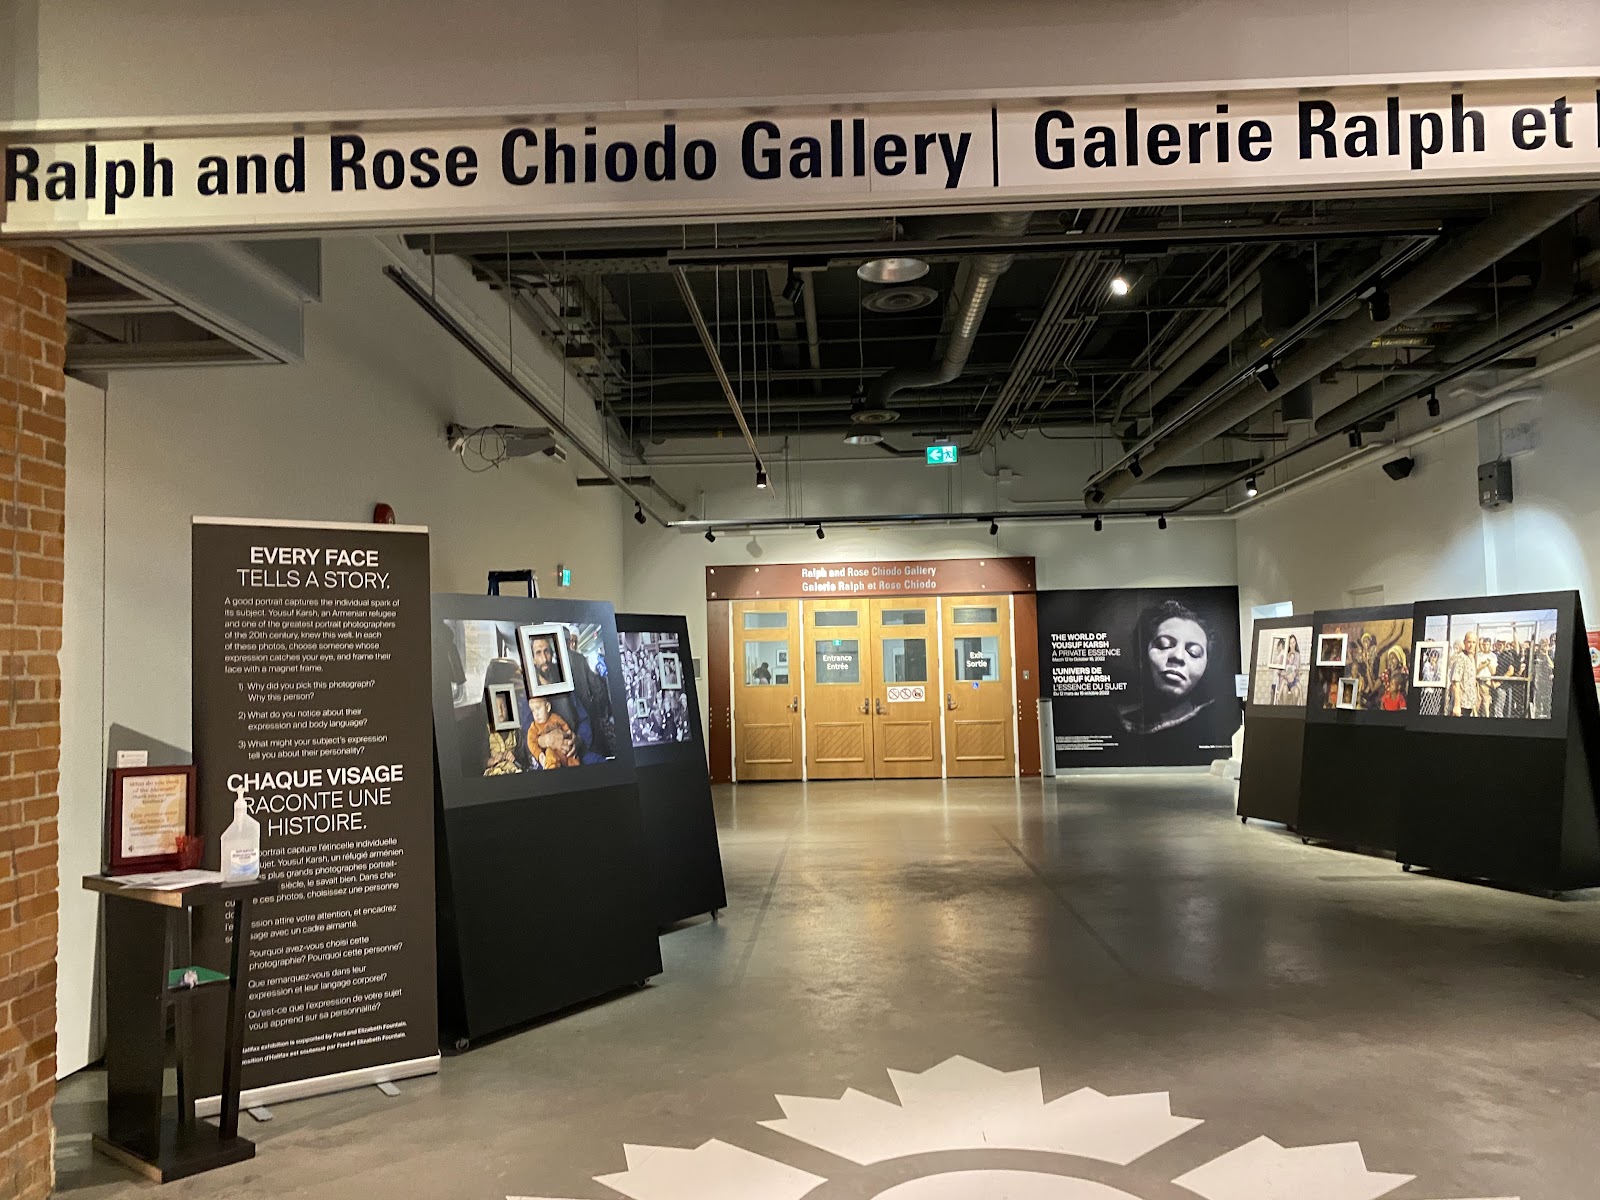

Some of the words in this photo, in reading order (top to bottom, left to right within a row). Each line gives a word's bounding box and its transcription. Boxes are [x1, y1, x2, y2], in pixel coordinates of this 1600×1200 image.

[1034, 104, 1272, 170] Galerie
[1300, 93, 1485, 170] Ralph
[1511, 95, 1573, 150] et
[5, 143, 173, 214] Ralph
[198, 137, 305, 194] and
[331, 134, 478, 191] Rose
[501, 123, 717, 186] Chiodo
[741, 119, 972, 189] Gallery
[250, 546, 320, 566] EVERY
[325, 549, 378, 567] FACE
[236, 568, 300, 587] TELLS
[305, 570, 319, 588] A
[324, 570, 390, 589] STORY.
[802, 567, 827, 579] Ralph
[829, 567, 845, 577] and
[848, 567, 869, 577] Rose
[872, 566, 902, 576] Chiodo
[904, 566, 936, 577] Gallery
[802, 581, 836, 592] Galerie
[838, 581, 864, 592] Ralph
[868, 582, 876, 590] et
[879, 580, 901, 590] Rose
[904, 579, 936, 589] Chiodo
[224, 596, 230, 606] A
[232, 596, 253, 608] good
[255, 596, 282, 608] portrait
[284, 597, 318, 608] captures
[320, 597, 332, 606] the
[334, 597, 369, 607] individual
[371, 597, 390, 609] spark
[392, 597, 399, 607] of
[224, 607, 234, 616] its
[268, 607, 294, 617] Yousuf
[332, 608, 367, 617] Armenian
[368, 608, 396, 620] refugee
[224, 619, 239, 628] and
[258, 619, 265, 628] of
[267, 619, 280, 628] the
[282, 619, 313, 630] greatest
[315, 619, 341, 630] portrait
[343, 619, 395, 630] photographers
[224, 630, 232, 639] of
[234, 630, 247, 639] the
[249, 630, 267, 639] 20th
[301, 630, 320, 639] knew
[322, 630, 335, 639] this
[355, 629, 362, 639] In
[363, 629, 381, 639] each
[224, 641, 232, 650] of
[234, 641, 256, 650] these
[289, 640, 317, 650] choose
[355, 640, 379, 650] whose
[224, 652, 268, 664] expression
[269, 652, 300, 661] catches
[302, 654, 318, 663] your
[337, 651, 350, 661] and
[352, 651, 373, 661] frame
[375, 651, 390, 660] their
[966, 659, 987, 668] Sortie
[225, 664, 242, 673] face
[243, 664, 260, 673] with
[268, 664, 297, 675] magnet
[826, 662, 848, 670] Entrée
[247, 681, 264, 692] Why
[266, 681, 278, 690] did
[280, 683, 294, 692] you
[296, 680, 311, 692] pick
[313, 680, 326, 689] this
[248, 692, 265, 703] Why
[267, 692, 281, 701] this
[238, 710, 245, 722] 2)
[247, 710, 267, 719] What
[270, 709, 280, 719] do
[282, 711, 295, 720] you
[298, 708, 320, 718] notice
[322, 708, 343, 717] about
[346, 707, 361, 717] their
[248, 720, 291, 732] expression
[292, 719, 307, 729] and
[309, 719, 327, 730] body
[238, 739, 246, 751] 3)
[247, 738, 268, 748] What
[270, 737, 292, 749] might
[294, 739, 309, 748] your
[312, 735, 345, 747] subject's
[347, 733, 387, 746] expression
[248, 750, 260, 760] tell
[261, 752, 275, 761] you
[278, 749, 299, 758] about
[301, 747, 317, 757] their
[227, 769, 322, 792] CHAQUE
[327, 765, 403, 785] VISAGE
[245, 790, 343, 815] RACONTE
[349, 787, 391, 807] UNE
[268, 812, 366, 837] HISTOIRE.
[249, 944, 283, 956] Pourquoi
[285, 942, 324, 953] avez-vous
[326, 937, 348, 948] choisi
[349, 936, 369, 946] cette
[307, 949, 341, 962] Pourquoi
[342, 948, 362, 958] cette
[248, 978, 265, 989] Que
[267, 971, 330, 985] remarquez-vous
[331, 968, 350, 977] dans
[352, 966, 366, 975] leur
[249, 986, 293, 1000] expression
[294, 984, 302, 994] et
[304, 983, 318, 992] leur
[320, 980, 351, 991] langage
[248, 1006, 287, 1020] Qu'est-ce
[289, 1004, 304, 1015] que
[306, 996, 351, 1011] l'expression
[352, 994, 362, 1004] de
[364, 992, 382, 1002] votre
[384, 988, 401, 1000] sujet
